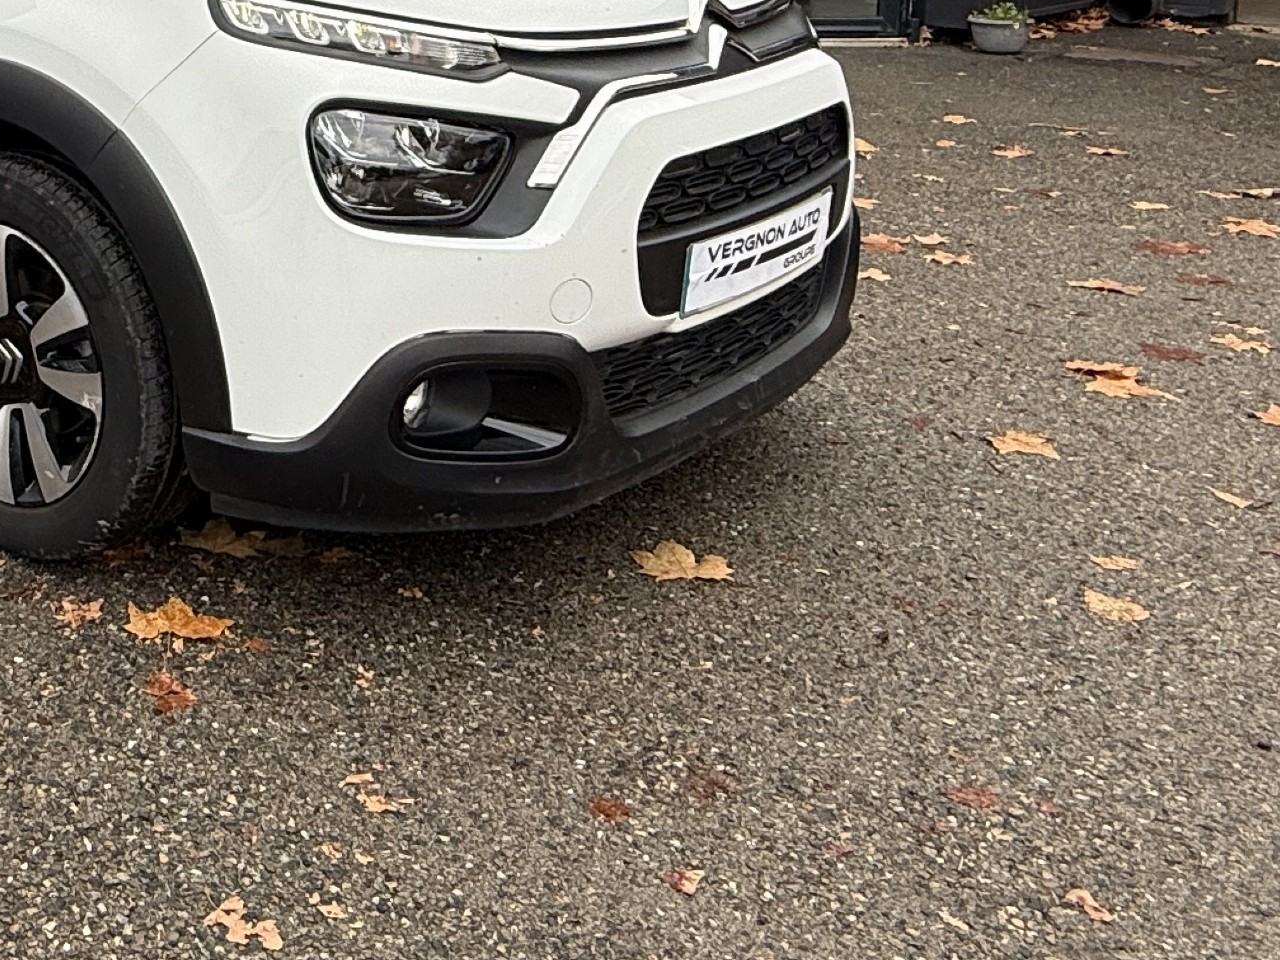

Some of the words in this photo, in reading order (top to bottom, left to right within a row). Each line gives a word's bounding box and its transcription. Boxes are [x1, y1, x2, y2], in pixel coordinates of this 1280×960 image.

[707, 223, 786, 264] VERGNON
[787, 208, 820, 236] AUTO
[783, 244, 816, 268] GROUPE
